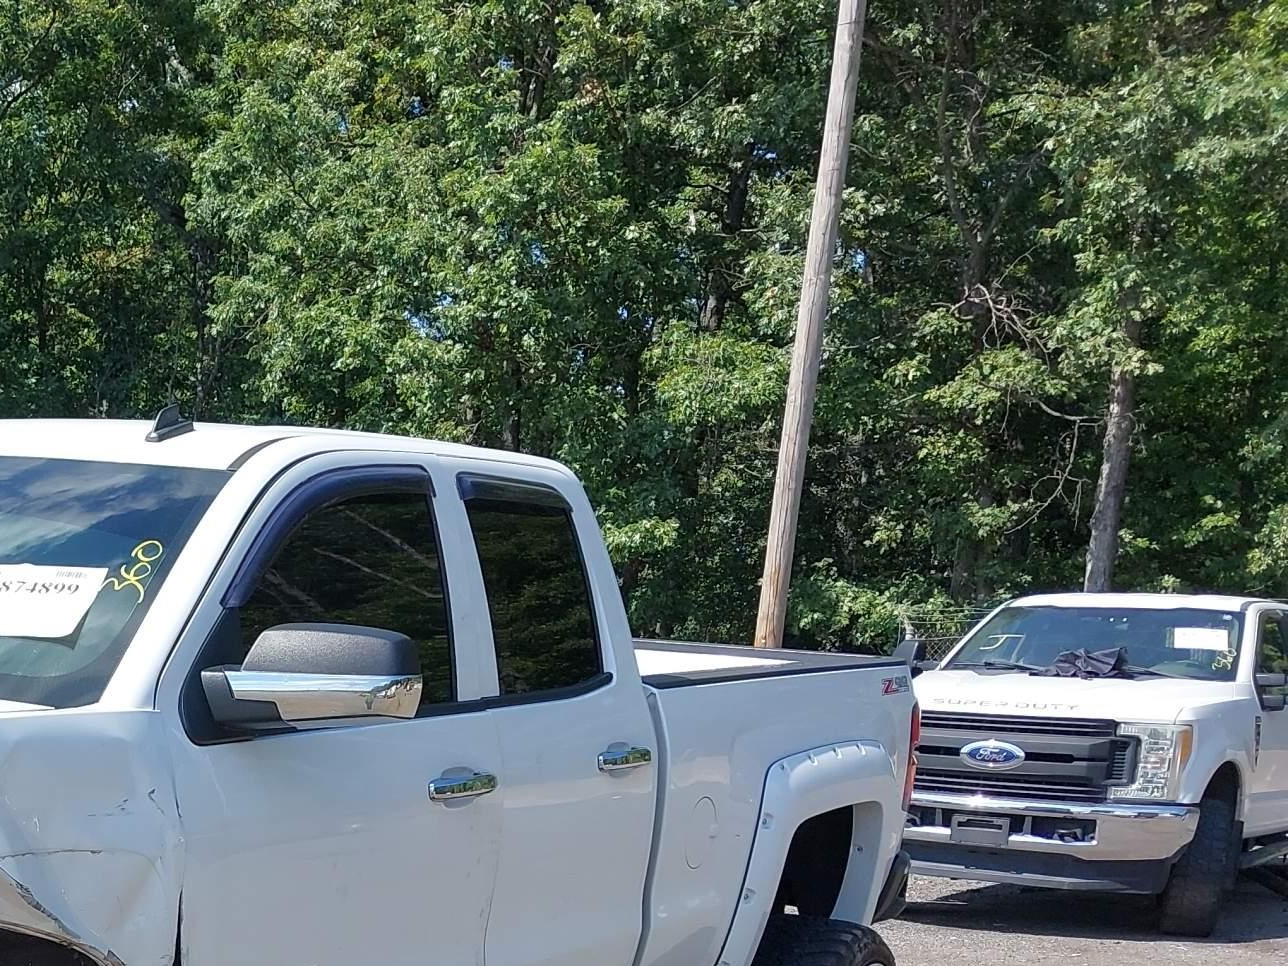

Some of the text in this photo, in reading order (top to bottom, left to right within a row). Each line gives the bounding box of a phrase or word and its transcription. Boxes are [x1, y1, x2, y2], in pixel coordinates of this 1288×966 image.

[98, 540, 163, 604] 360
[933, 698, 1080, 711] SUPER DUTY
[975, 747, 1008, 761] Ford
